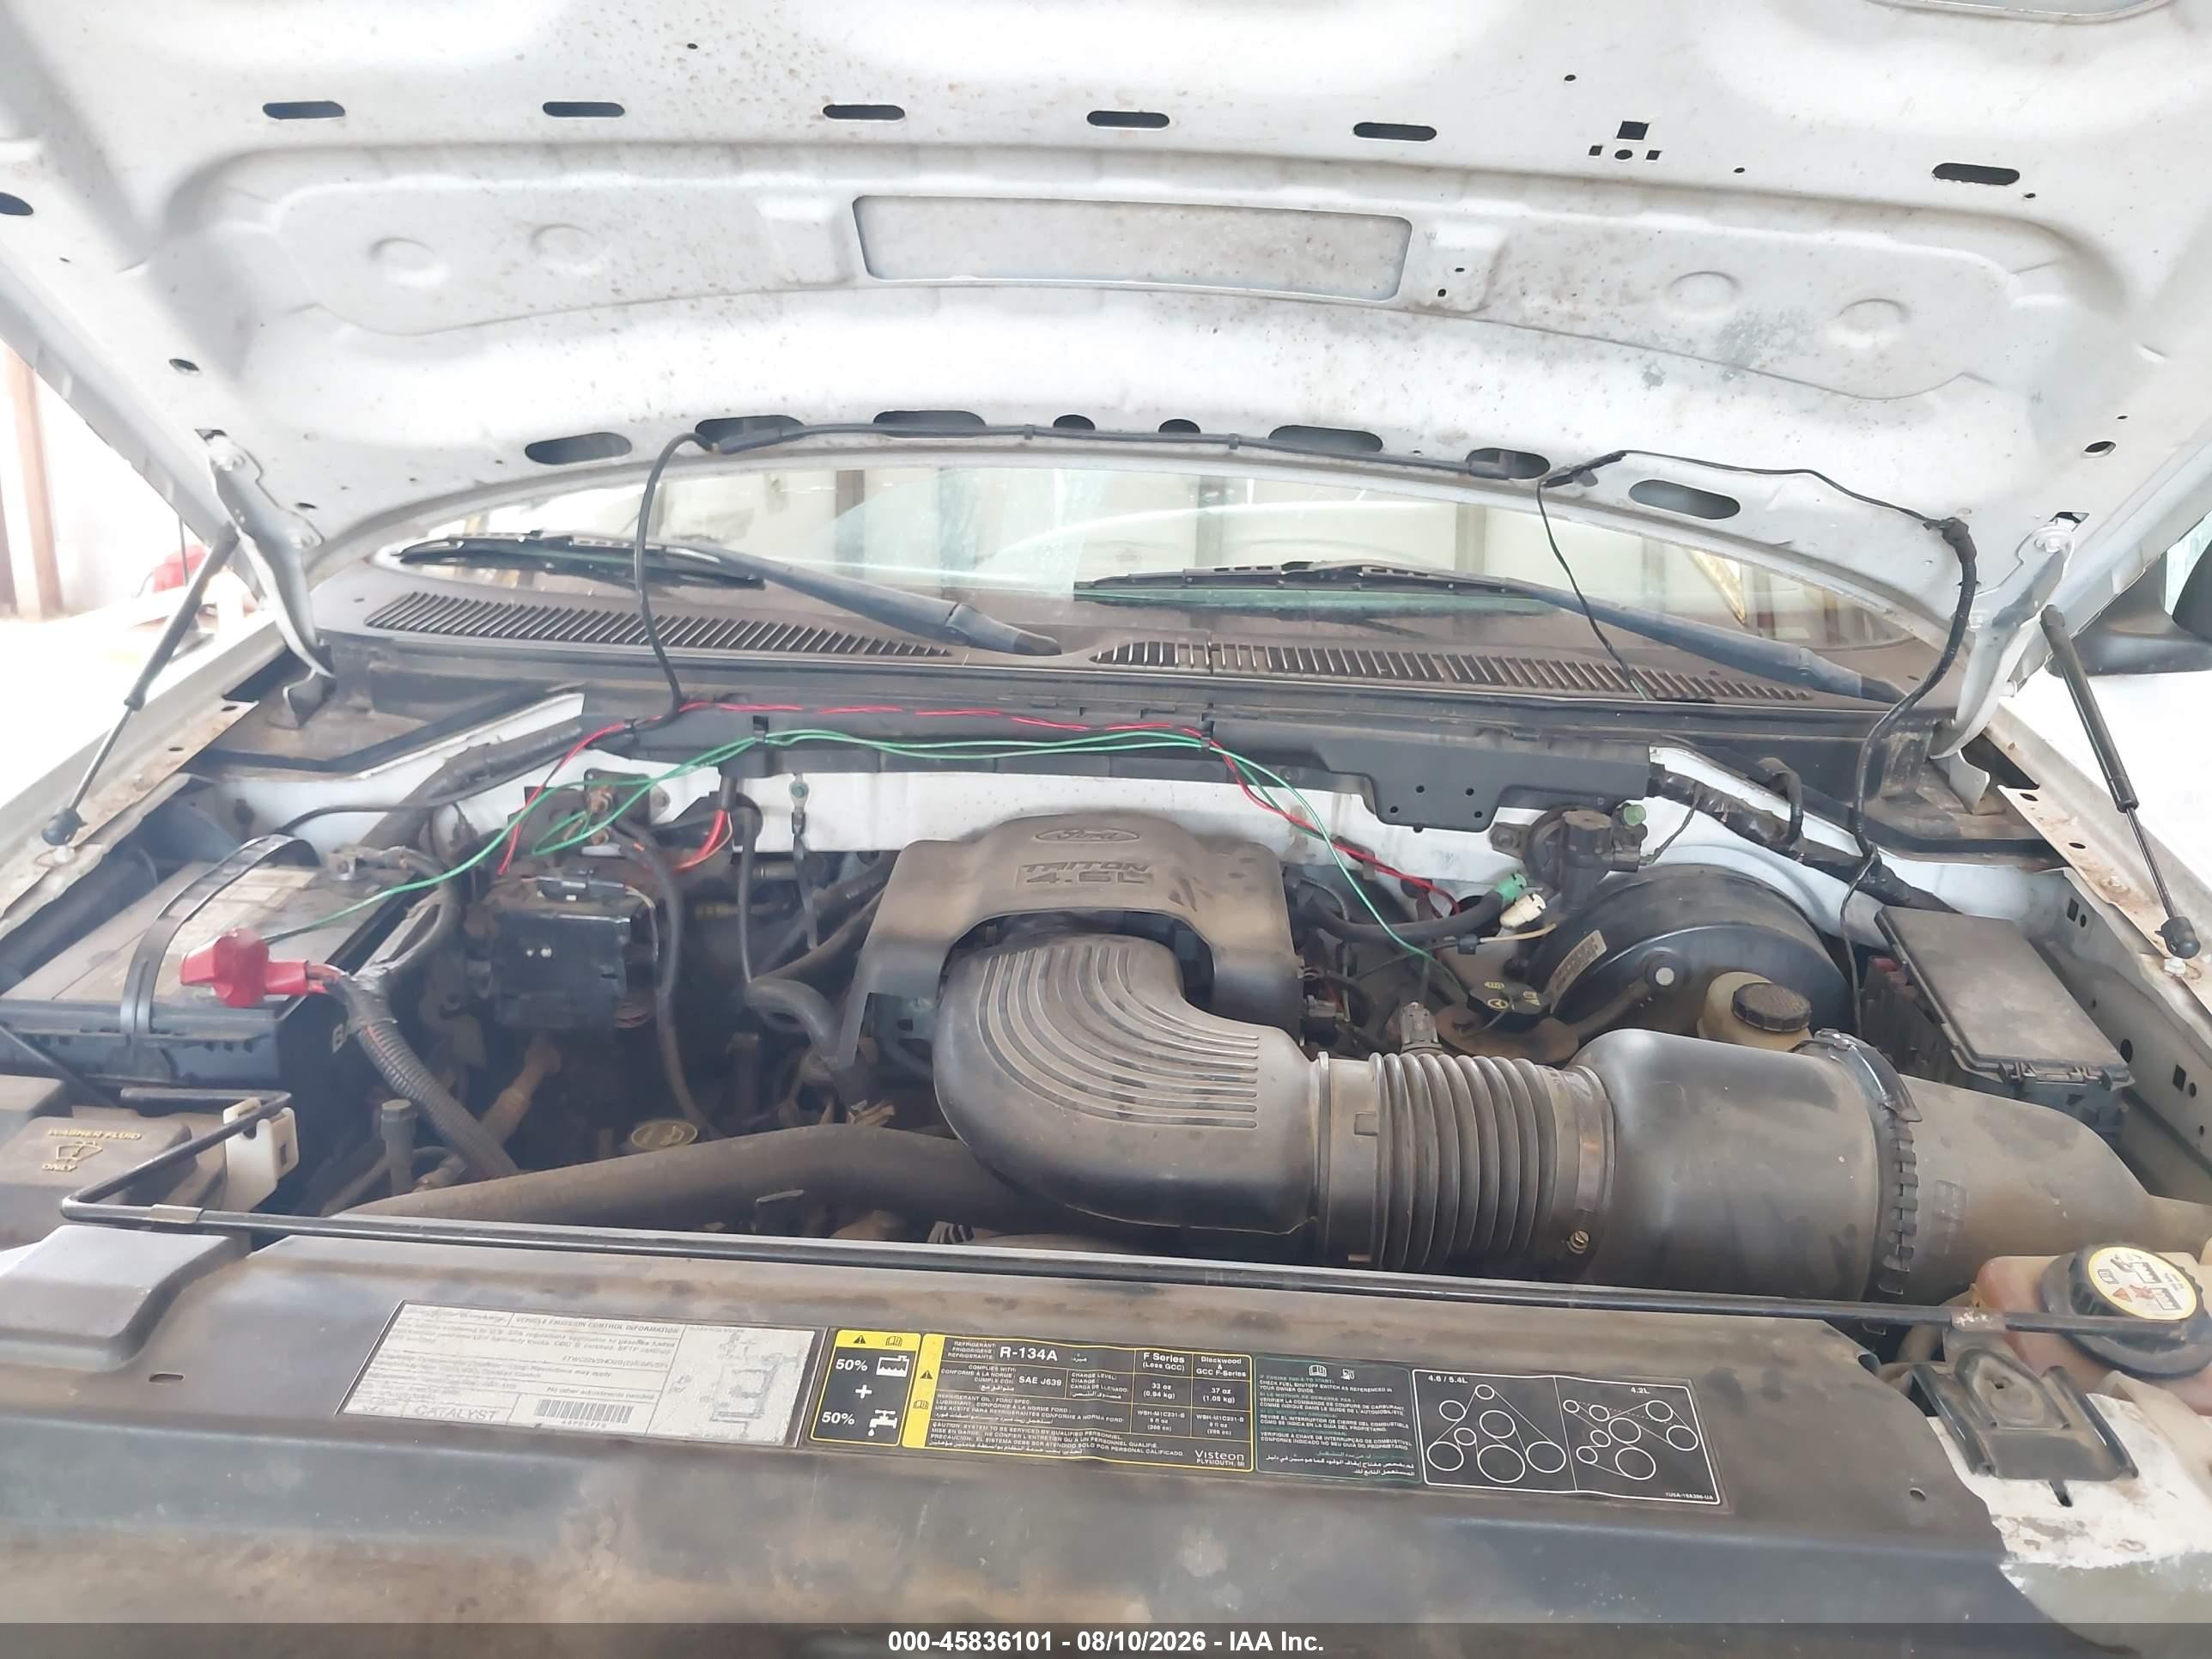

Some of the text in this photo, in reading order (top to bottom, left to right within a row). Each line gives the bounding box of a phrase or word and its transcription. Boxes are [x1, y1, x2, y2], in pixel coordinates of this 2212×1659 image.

[1023, 860, 1149, 872] TRITON
[1027, 872, 1145, 884] 4.6L
[1000, 1346, 1058, 1361] R-134A
[1144, 1352, 1185, 1364] F Series
[836, 1358, 867, 1371] 50%
[1200, 1356, 1242, 1364] Blackwood
[1164, 1364, 1185, 1372] GCC)
[1018, 1376, 1037, 1384] SAE
[1449, 1376, 1468, 1384] 5.4L
[1164, 1391, 1176, 1400] kg)
[1631, 1386, 1651, 1395] 4.2L
[415, 1405, 499, 1422] CATALYST
[822, 1411, 854, 1425] 50%
[1194, 1449, 1244, 1461] Visteon
